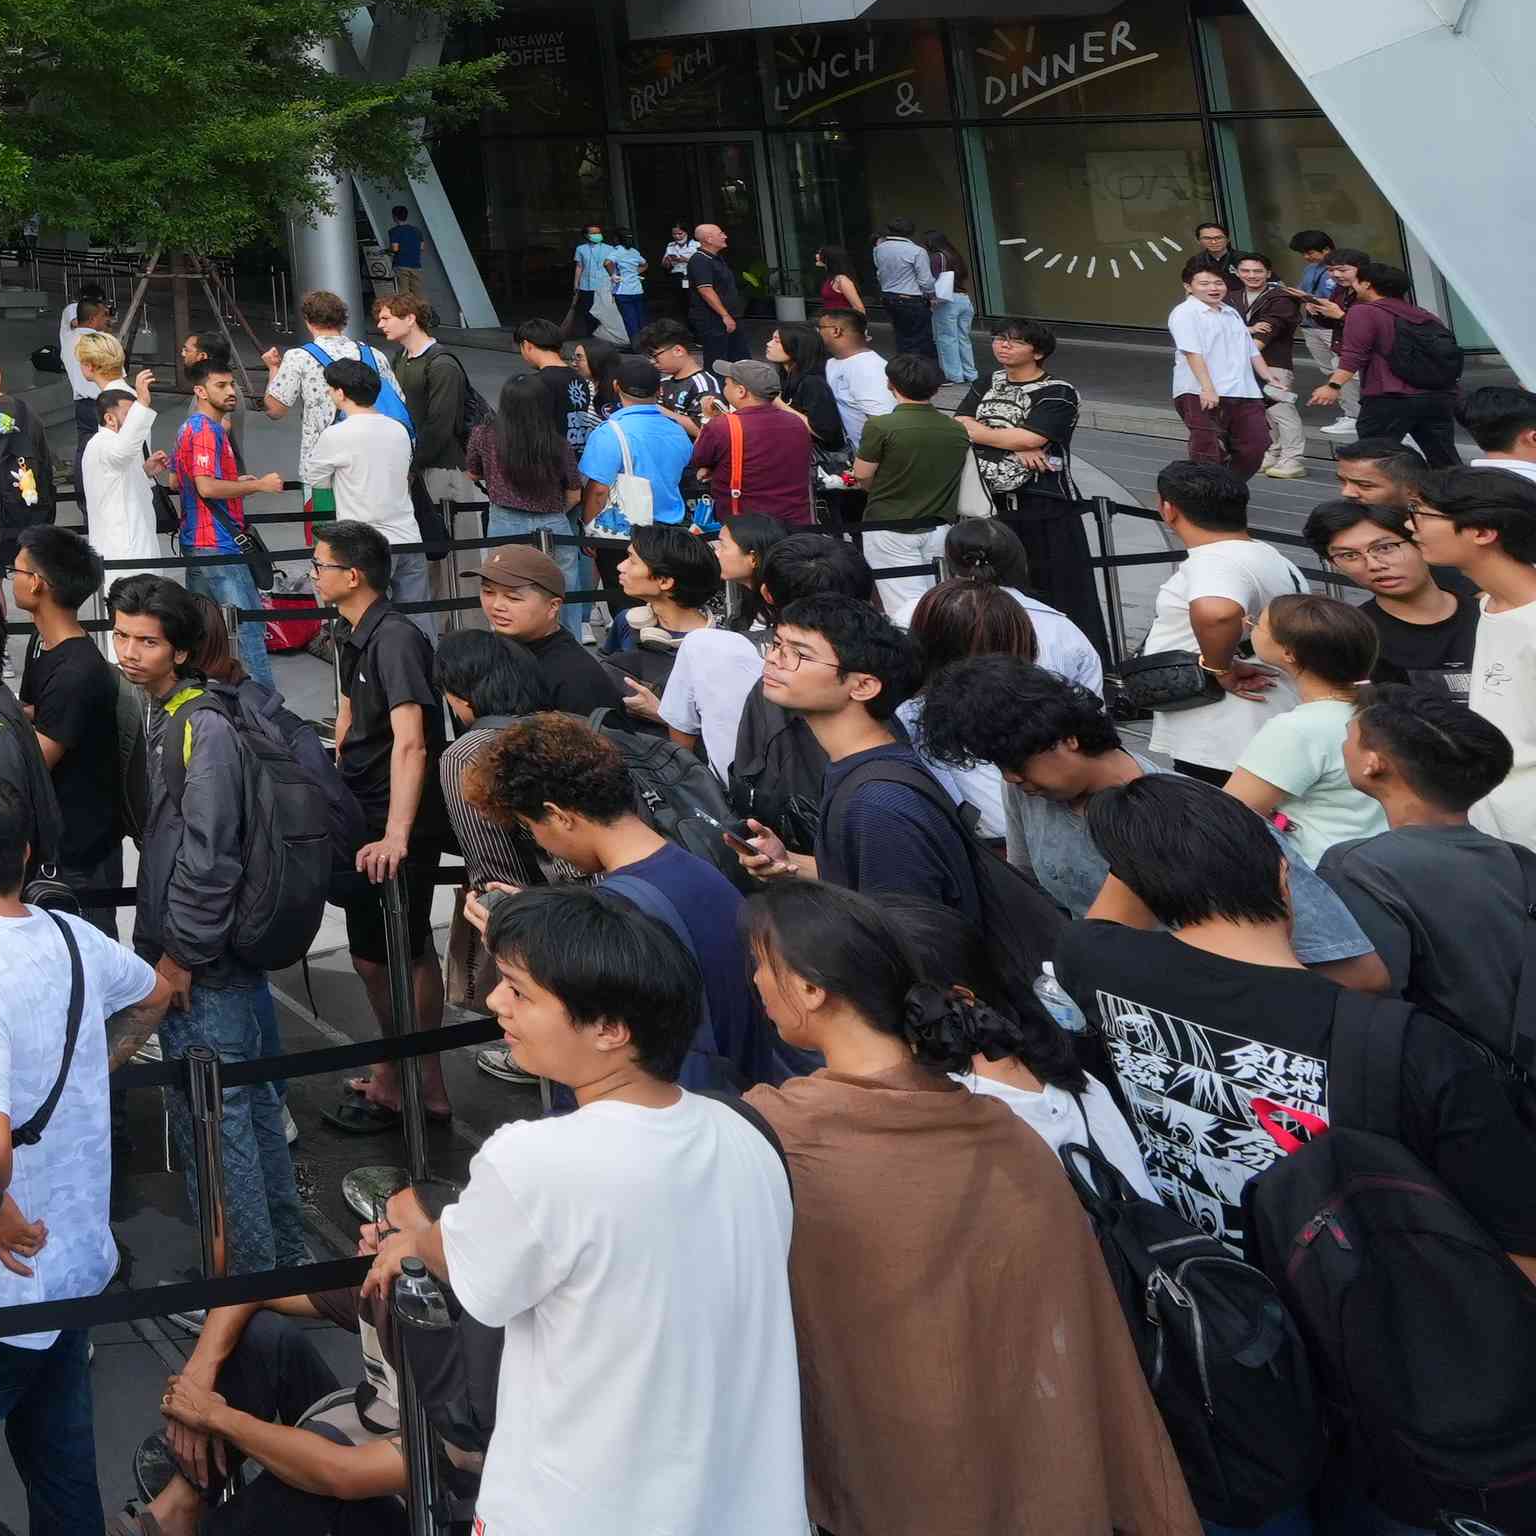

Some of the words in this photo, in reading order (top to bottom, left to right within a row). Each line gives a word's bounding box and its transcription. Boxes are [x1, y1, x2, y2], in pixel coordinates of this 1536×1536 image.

[496, 31, 566, 48] TAKEAWAY
[500, 46, 568, 65] OFFEE
[629, 39, 714, 121] BRUNCH
[773, 38, 876, 113] LUNCH
[895, 81, 924, 118] &
[984, 20, 1137, 106] DINNER
